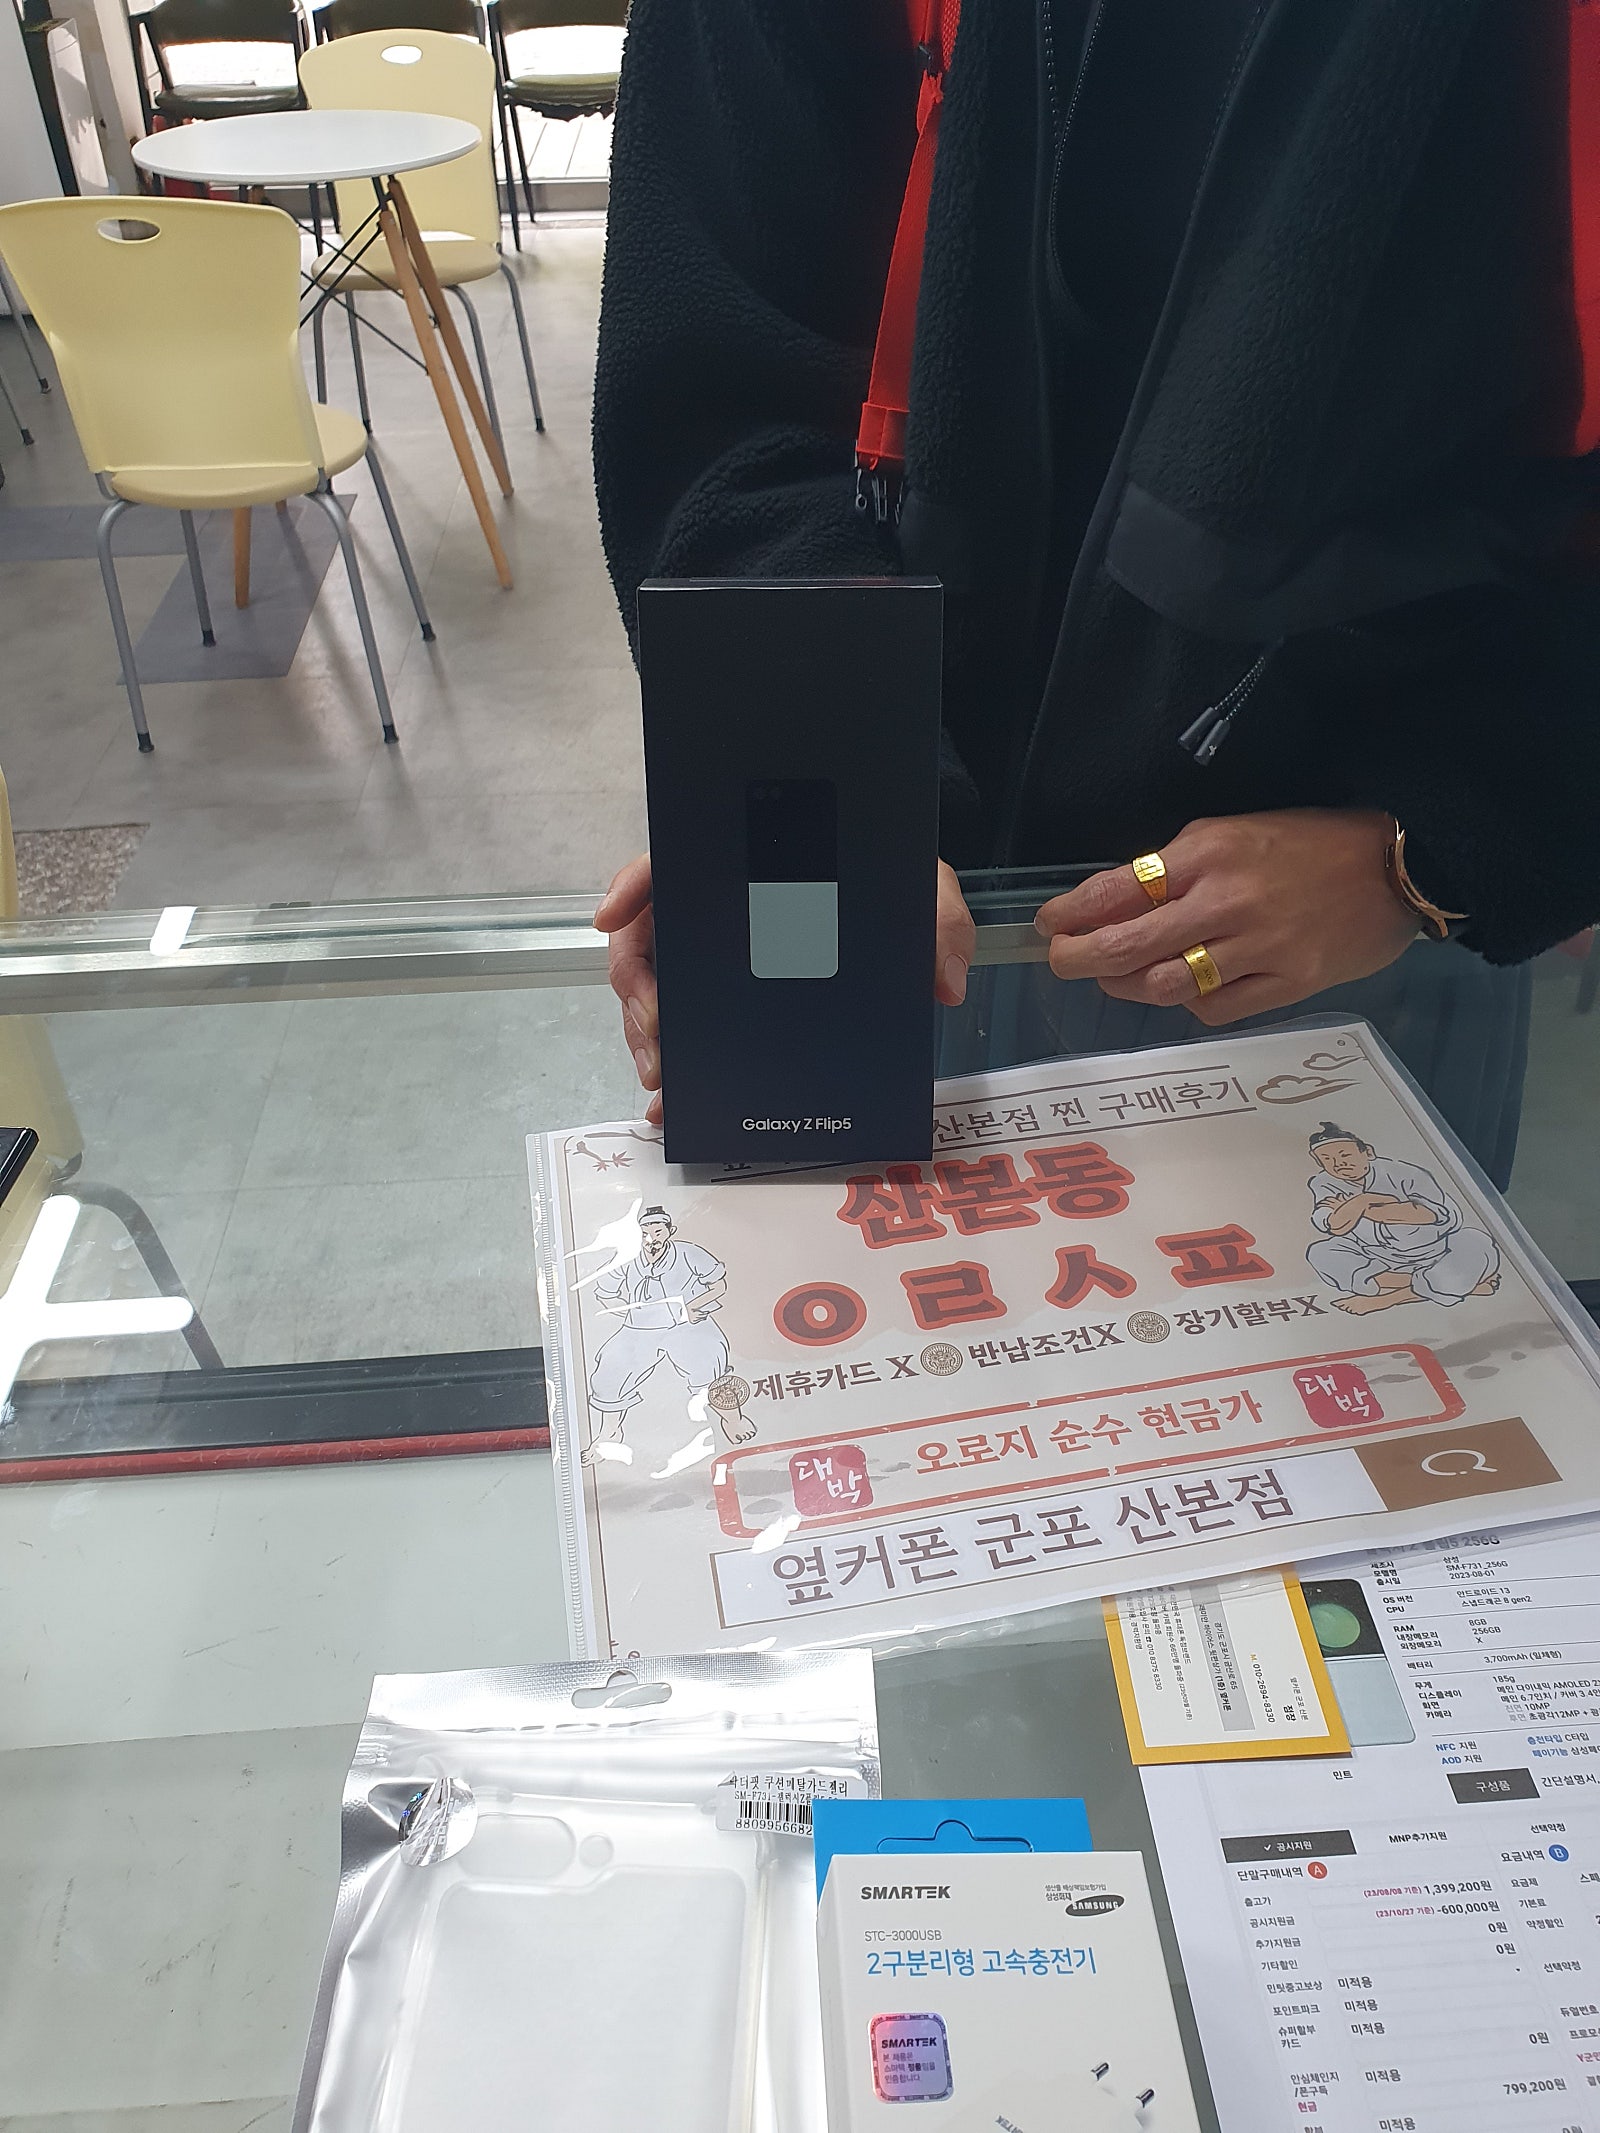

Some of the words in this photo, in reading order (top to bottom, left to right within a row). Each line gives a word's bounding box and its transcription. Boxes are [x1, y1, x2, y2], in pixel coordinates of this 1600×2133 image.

[933, 1103, 1037, 1143] 산본점
[1050, 1100, 1089, 1128] 찐
[1097, 1075, 1251, 1123] 구매후기
[742, 1117, 801, 1133] Galaxy
[803, 1118, 813, 1130] Z
[815, 1117, 852, 1133] Flip5
[837, 1141, 1136, 1249] 산본동
[753, 1358, 883, 1402] 제휴카드
[889, 1353, 920, 1380] X
[916, 1425, 1042, 1475] 오로지
[1048, 1411, 1133, 1455] 순수
[1142, 1389, 1265, 1440] 현금가
[773, 1526, 960, 1606] 옆커폰
[974, 1504, 1103, 1569] 군포
[1116, 1467, 1297, 1545] 산본점
[1463, 1534, 1501, 1547] 256G
[1446, 1560, 1508, 1572] SM-F731_256G
[1449, 1569, 1496, 1580] 2023-08-01
[1382, 1596, 1396, 1604] OS
[1397, 1594, 1414, 1604] 버전
[1456, 1588, 1498, 1598] 안드로이드
[1499, 1587, 1511, 1596] 13
[1386, 1605, 1405, 1613] CPU
[1510, 1595, 1533, 1606] gen2
[1393, 1624, 1415, 1632] RAM
[1468, 1618, 1488, 1627] 8GB
[1472, 1626, 1502, 1635] 256GB
[1147, 1643, 1155, 1655] 010
[1149, 1656, 1159, 1673] 8375
[1484, 1654, 1528, 1664] 3,700mAh
[1153, 1673, 1163, 1691] 8330
[1230, 1680, 1238, 1690] 65
[1492, 1675, 1516, 1684] 185g
[1253, 1663, 1276, 1723] 010-2694-8330
[1418, 1689, 1463, 1700] 디스플레이
[1553, 1679, 1591, 1689] AMOLED
[1284, 1705, 1297, 1721] 점장
[1524, 1702, 1551, 1711] 10MP
[1435, 1743, 1456, 1751] NFC
[1459, 1741, 1478, 1750] 지원
[1564, 1732, 1590, 1742] C타입
[1441, 1756, 1462, 1765] AOD
[1464, 1754, 1483, 1764] 지원
[1333, 1770, 1353, 1780] 민트
[1476, 1781, 1511, 1793] 구성품
[735, 1818, 813, 1836] 8809956682
[1276, 1840, 1313, 1852] 공시지원
[1388, 1831, 1448, 1844] MNP추가지원
[1500, 1849, 1546, 1862] 요금내역
[1237, 1866, 1303, 1881] 단말구매내역
[1423, 1880, 1493, 1896] 1,399,200원
[1511, 1877, 1539, 1888] 요금제
[860, 1885, 951, 1900] SMARTEK
[1072, 1901, 1119, 1910] SAMSUNG
[1519, 1898, 1547, 1909] 기본료
[1249, 1916, 1295, 1929] 공시지원금
[1437, 1900, 1501, 1916] -600,000원
[1526, 1918, 1565, 1930] 약정할인
[864, 1929, 942, 1943] STC-3000USB
[1255, 1937, 1301, 1950] 추가지원금
[1488, 1921, 1508, 1933] 0원
[866, 1947, 975, 1979] 2구분리형
[982, 1947, 1097, 1977] 고속충전기
[1261, 1959, 1299, 1971] 기타할인
[1496, 1943, 1517, 1955] 0원
[1338, 1976, 1373, 1990] 미적용
[1273, 2003, 1321, 2016] 포인트파크
[1344, 1999, 1379, 2013] 미적용
[1351, 2022, 1385, 2036] 미적용
[881, 2037, 937, 2049] SMARTEK
[1281, 2038, 1302, 2049] 카드
[1528, 2032, 1550, 2045] 0원
[1290, 2071, 1340, 2085] 안심체인지
[1365, 2069, 1401, 2084] 미적용
[1503, 2077, 1567, 2095] 799,200원
[1379, 2117, 1416, 2132] 미적용
